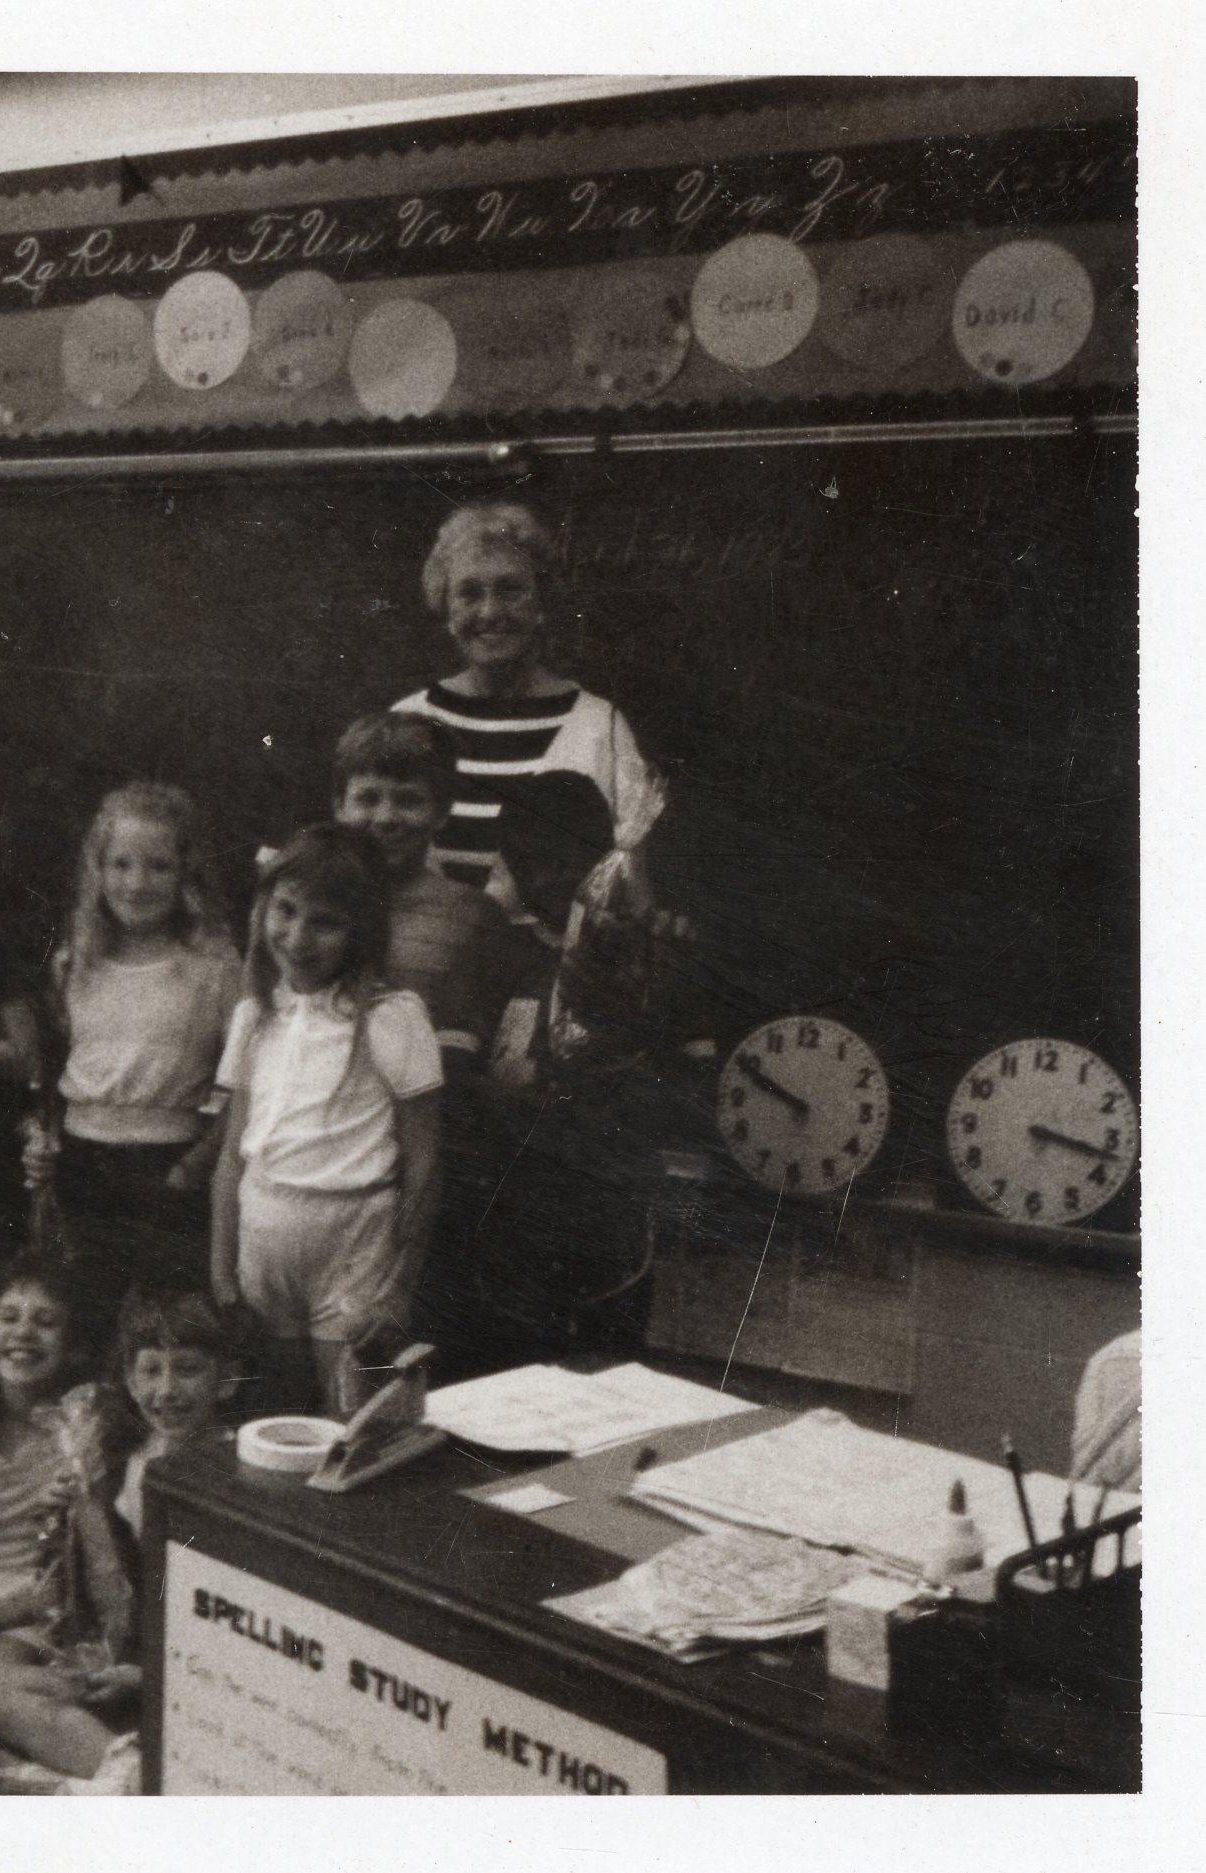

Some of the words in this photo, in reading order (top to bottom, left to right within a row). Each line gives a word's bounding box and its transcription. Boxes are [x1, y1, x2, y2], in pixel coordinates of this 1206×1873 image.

[965, 295, 1037, 328] David
[1050, 297, 1070, 325] C
[766, 1029, 784, 1055] 11
[798, 1022, 821, 1050] 12
[836, 1041, 847, 1061] 1
[1034, 1049, 1060, 1073] 12
[1000, 1053, 1019, 1078] 11
[1077, 1061, 1089, 1085] 1
[855, 1067, 873, 1089] 2
[969, 1077, 993, 1100] 10
[1099, 1092, 1118, 1115] 2
[961, 1112, 978, 1134] 9
[843, 1136, 861, 1157] 4
[1104, 1128, 1122, 1150] 3
[966, 1145, 983, 1168] 8
[1089, 1164, 1107, 1187] 4
[992, 1177, 1008, 1199] 7
[1064, 1186, 1080, 1210] 5
[1025, 1190, 1043, 1213] 6
[192, 1586, 326, 1674] SPELLING
[348, 1658, 453, 1733] STUDY
